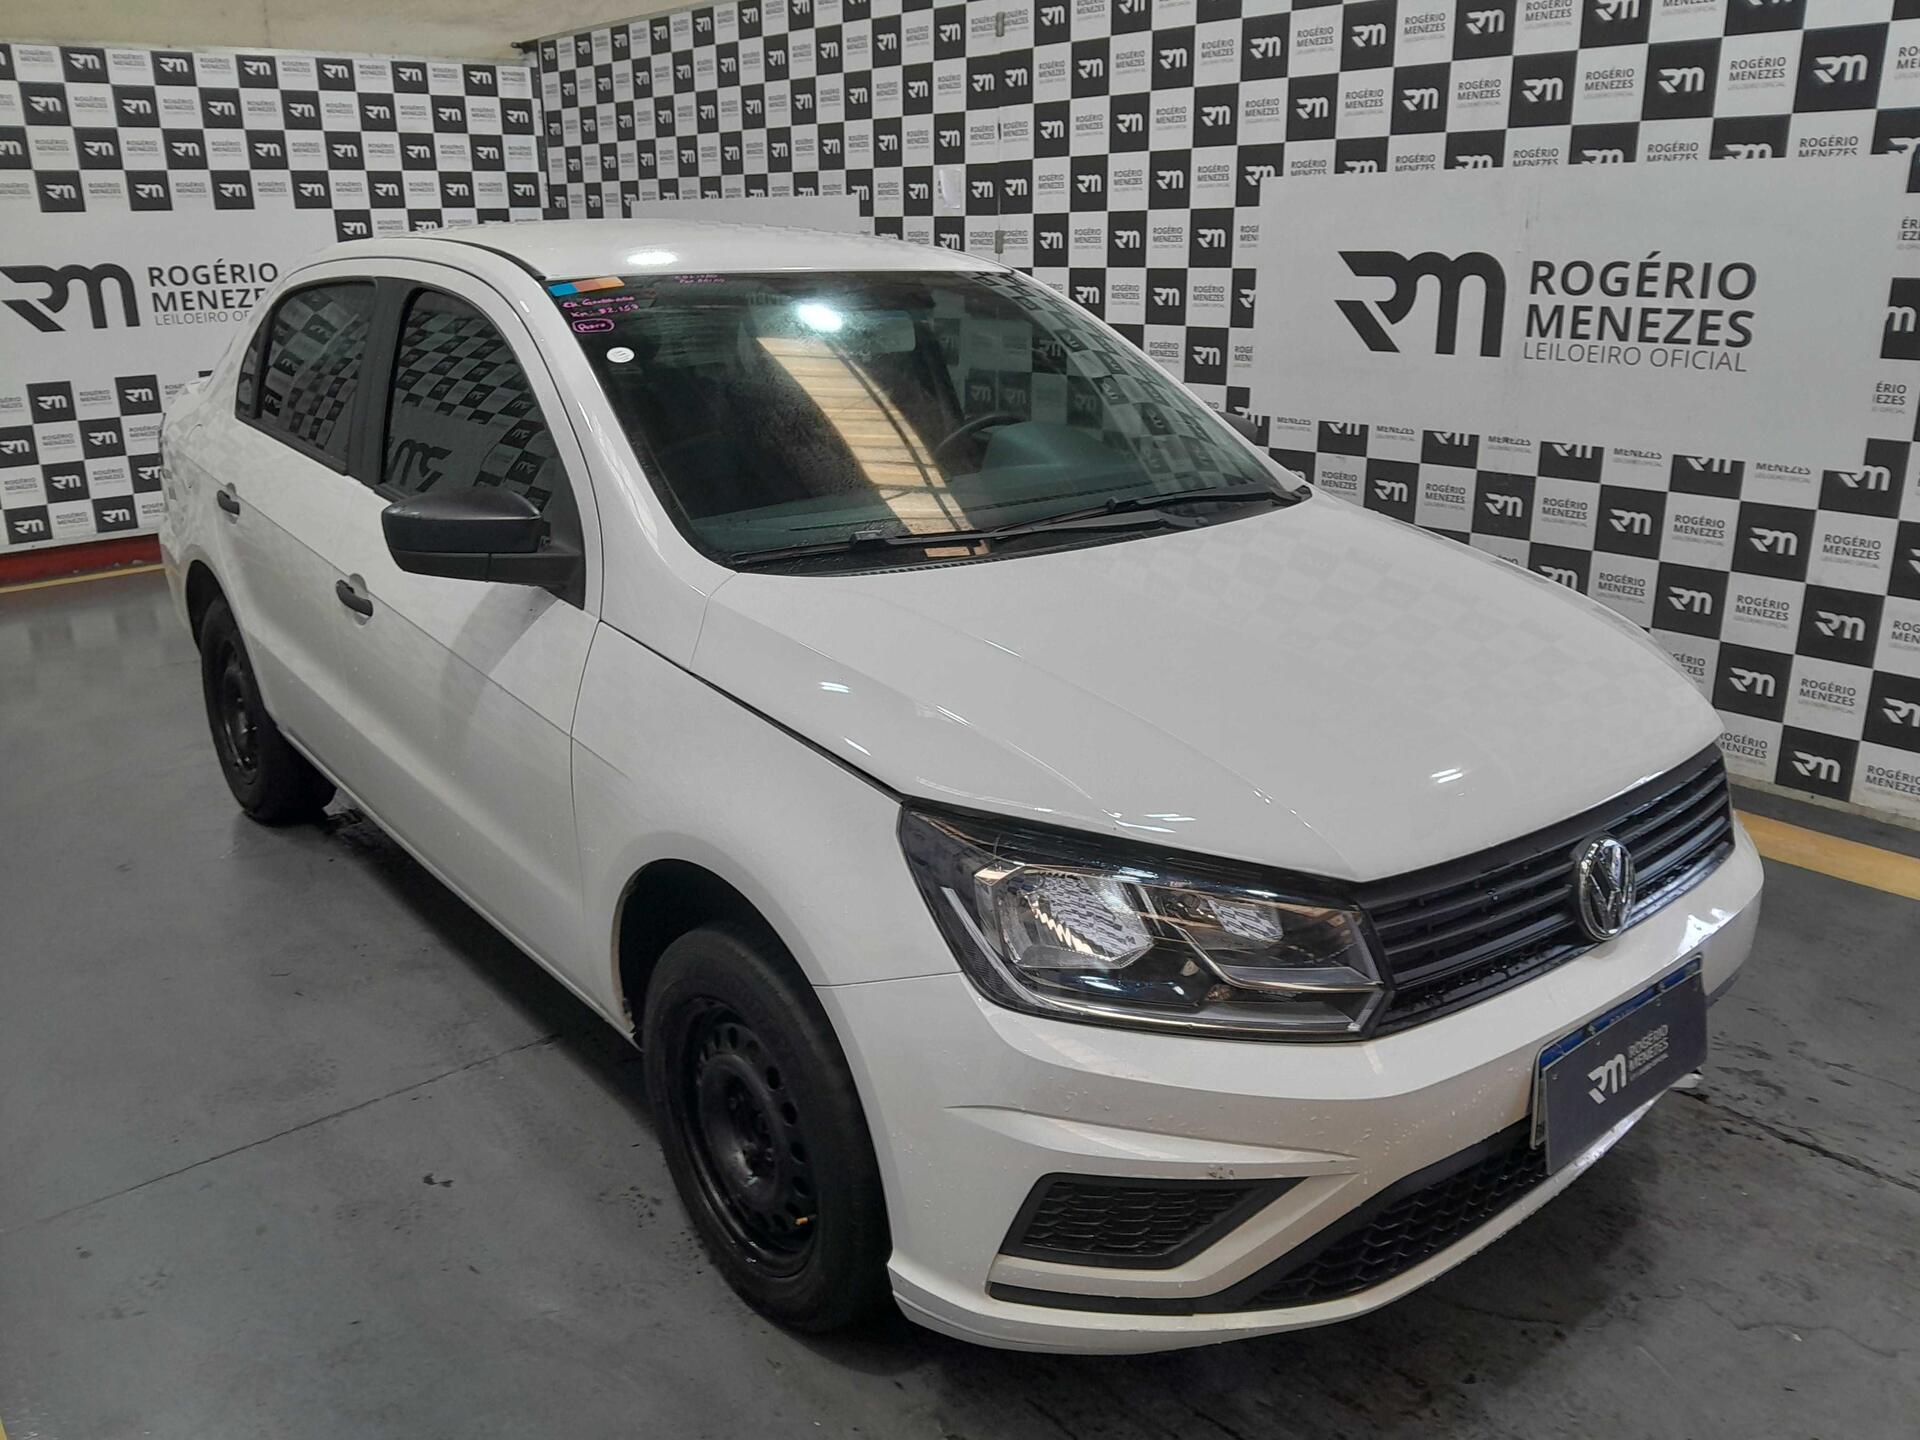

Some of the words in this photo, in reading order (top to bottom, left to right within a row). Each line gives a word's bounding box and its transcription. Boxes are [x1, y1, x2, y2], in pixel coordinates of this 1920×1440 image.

[1526, 0, 1572, 11] ROGÉRIO
[1405, 12, 1445, 24] ROGÉRIO
[1525, 8, 1571, 21] MENEZES
[1404, 23, 1445, 35] MENEZES
[1731, 56, 1786, 69] ROGÉRIO
[1586, 68, 1634, 80] ROGÉRIO
[1729, 69, 1786, 81] MENEZES
[1459, 78, 1501, 90] ROGÉRIO
[1585, 79, 1633, 90] MENEZES
[1458, 89, 1500, 100] MENEZES
[1647, 141, 1699, 153] ROGÉRIO
[1800, 135, 1859, 148] ROGÉRIO
[1395, 154, 1436, 164] ROGÉRIO
[1513, 148, 1559, 159] ROGÉRIO
[1291, 159, 1327, 169] ROGÉRIO
[148, 258, 278, 287] ROGÉRIO
[1530, 251, 1756, 300] ROGÉRIO
[154, 312, 228, 326] LEILOEIRO
[1526, 304, 1754, 348] MENEZES
[1524, 342, 1641, 365] LEILOEIRO
[1650, 348, 1746, 372] OFICIAL
[1426, 483, 1465, 495] ROGÉRIO
[1425, 492, 1465, 504] MENEZES
[1543, 497, 1588, 510] ROGÉRIO
[1542, 507, 1587, 520] MENEZES
[1675, 514, 1725, 528] ROGÉRIO
[1673, 525, 1724, 538] MENEZES
[1824, 534, 1881, 549] ROGÉRIO
[1823, 545, 1880, 560] MENEZES
[1599, 572, 1645, 587] ROGÉRIO
[1598, 582, 1645, 596] MENEZES
[1737, 594, 1789, 611] ROGÉRIO
[1736, 605, 1788, 621] MENEZES
[1801, 678, 1856, 696] ROGÉRIO
[1800, 688, 1854, 706] MENEZES
